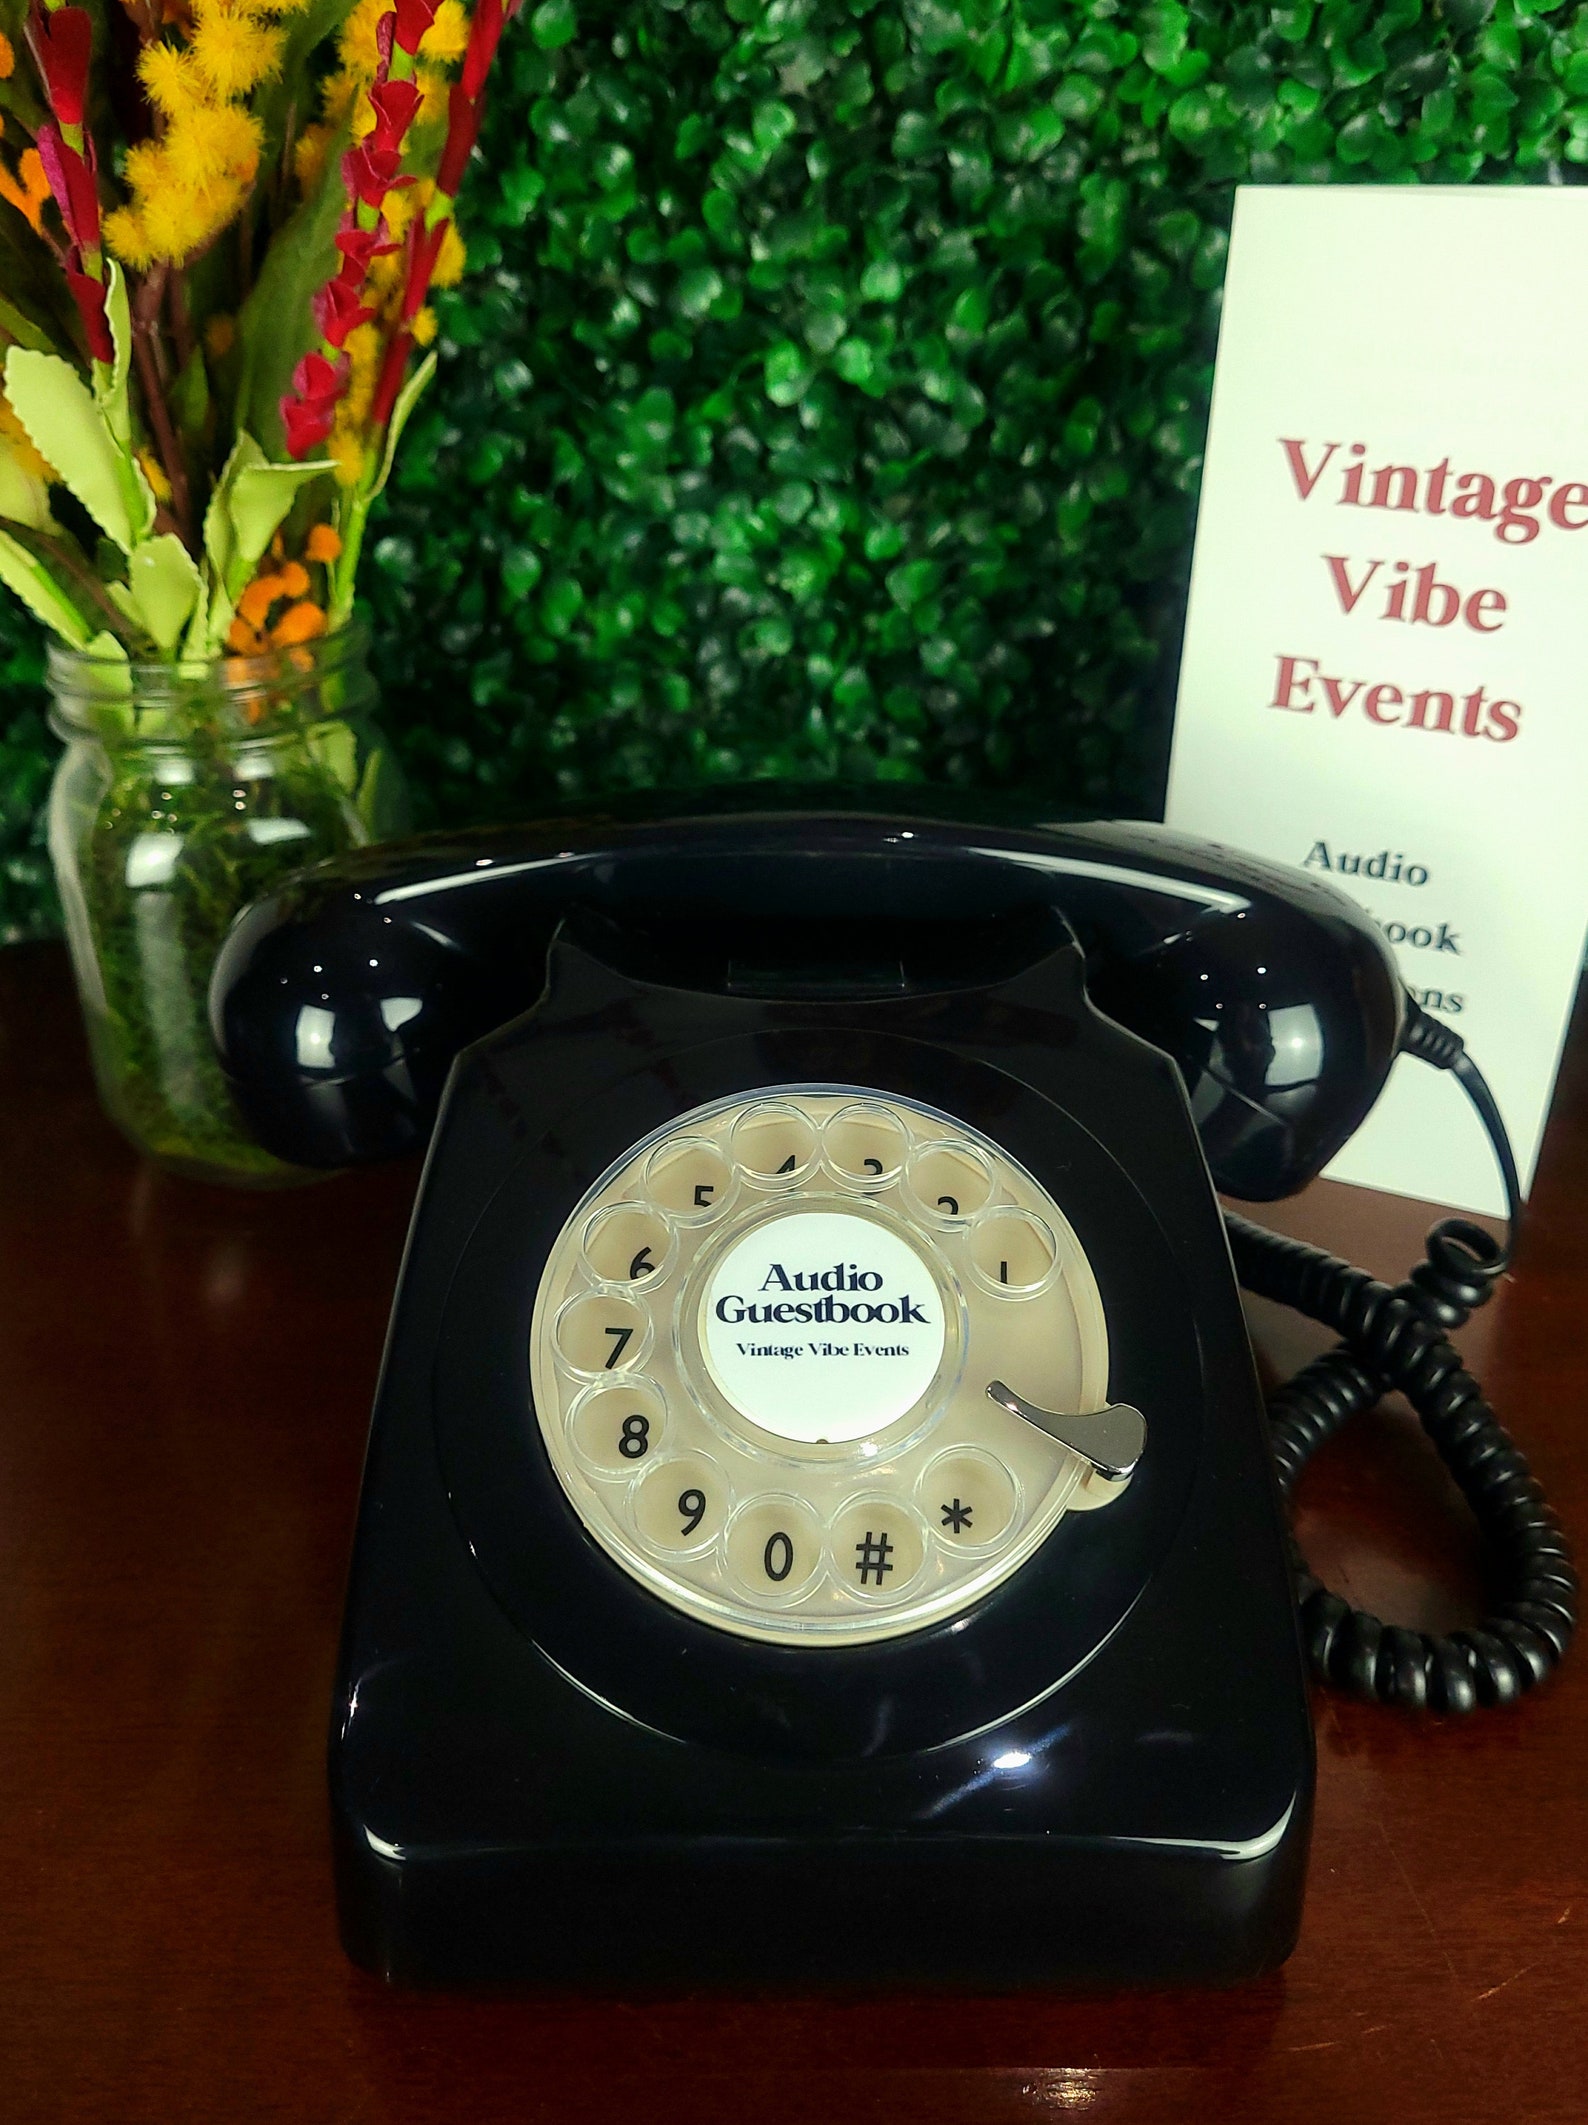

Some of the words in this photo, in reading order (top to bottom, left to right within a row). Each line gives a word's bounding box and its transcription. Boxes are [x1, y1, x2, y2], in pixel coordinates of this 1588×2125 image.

[1279, 437, 1588, 545] Vintage
[1322, 554, 1508, 633] Vibe
[1268, 654, 1523, 743] Events
[1303, 841, 1430, 887] Audio
[629, 1246, 656, 1281] 6
[757, 1262, 884, 1292] Audio
[715, 1293, 931, 1324] Guestbook
[604, 1327, 634, 1370] 7
[736, 1342, 804, 1360] Vintage
[807, 1342, 850, 1357] Vibe
[853, 1342, 910, 1357] Events
[618, 1414, 650, 1459] 8
[678, 1488, 706, 1537] 9
[855, 1531, 894, 1586] #
